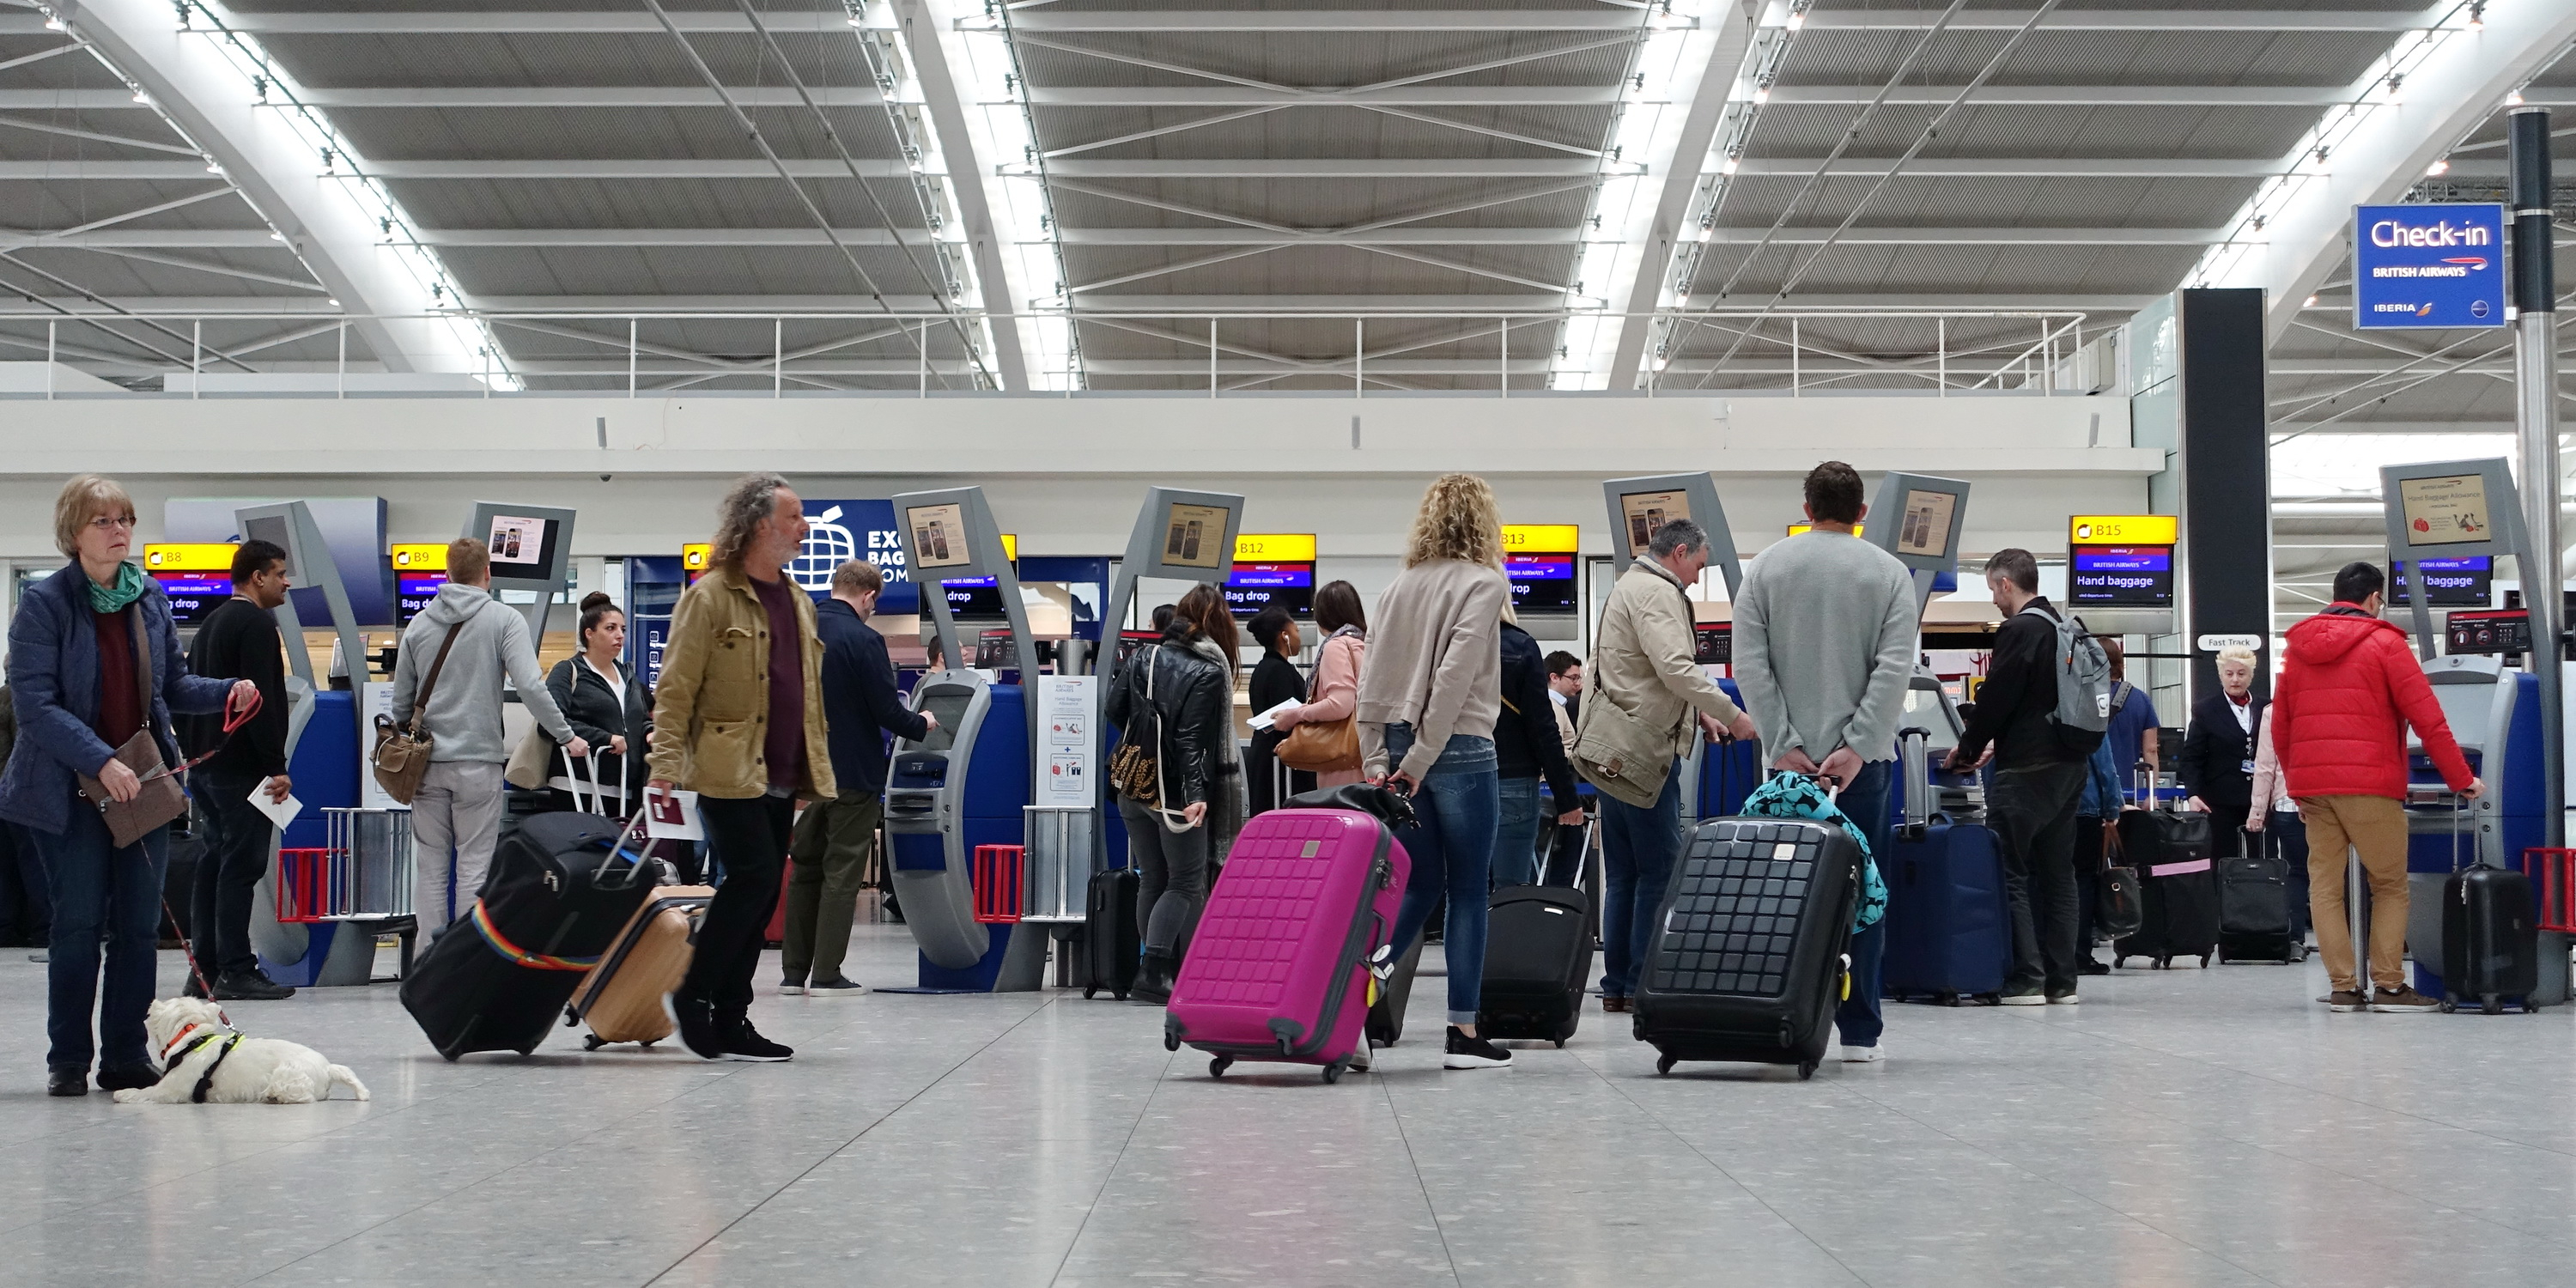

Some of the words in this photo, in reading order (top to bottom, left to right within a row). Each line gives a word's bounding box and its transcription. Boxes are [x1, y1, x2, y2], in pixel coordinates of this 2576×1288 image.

[2371, 221, 2488, 247] Check-in
[2372, 267, 2417, 277] BRITISH
[2418, 267, 2465, 276] AIRWAYS
[2373, 304, 2416, 313] IBERIA
[2096, 525, 2122, 536] B15
[868, 531, 902, 549] EX
[1502, 533, 1525, 544] B13
[1240, 543, 1264, 554] B12
[167, 551, 181, 562] B8
[414, 552, 429, 562] B9
[2077, 575, 2105, 586] Hand
[2107, 575, 2154, 587] baggage
[2427, 575, 2473, 587] baggage
[1510, 583, 1530, 595] rop
[947, 591, 971, 603] drop
[1225, 591, 1244, 602] Bag
[1246, 591, 1270, 602] drop
[175, 598, 199, 611] drop
[402, 598, 420, 610] Bag
